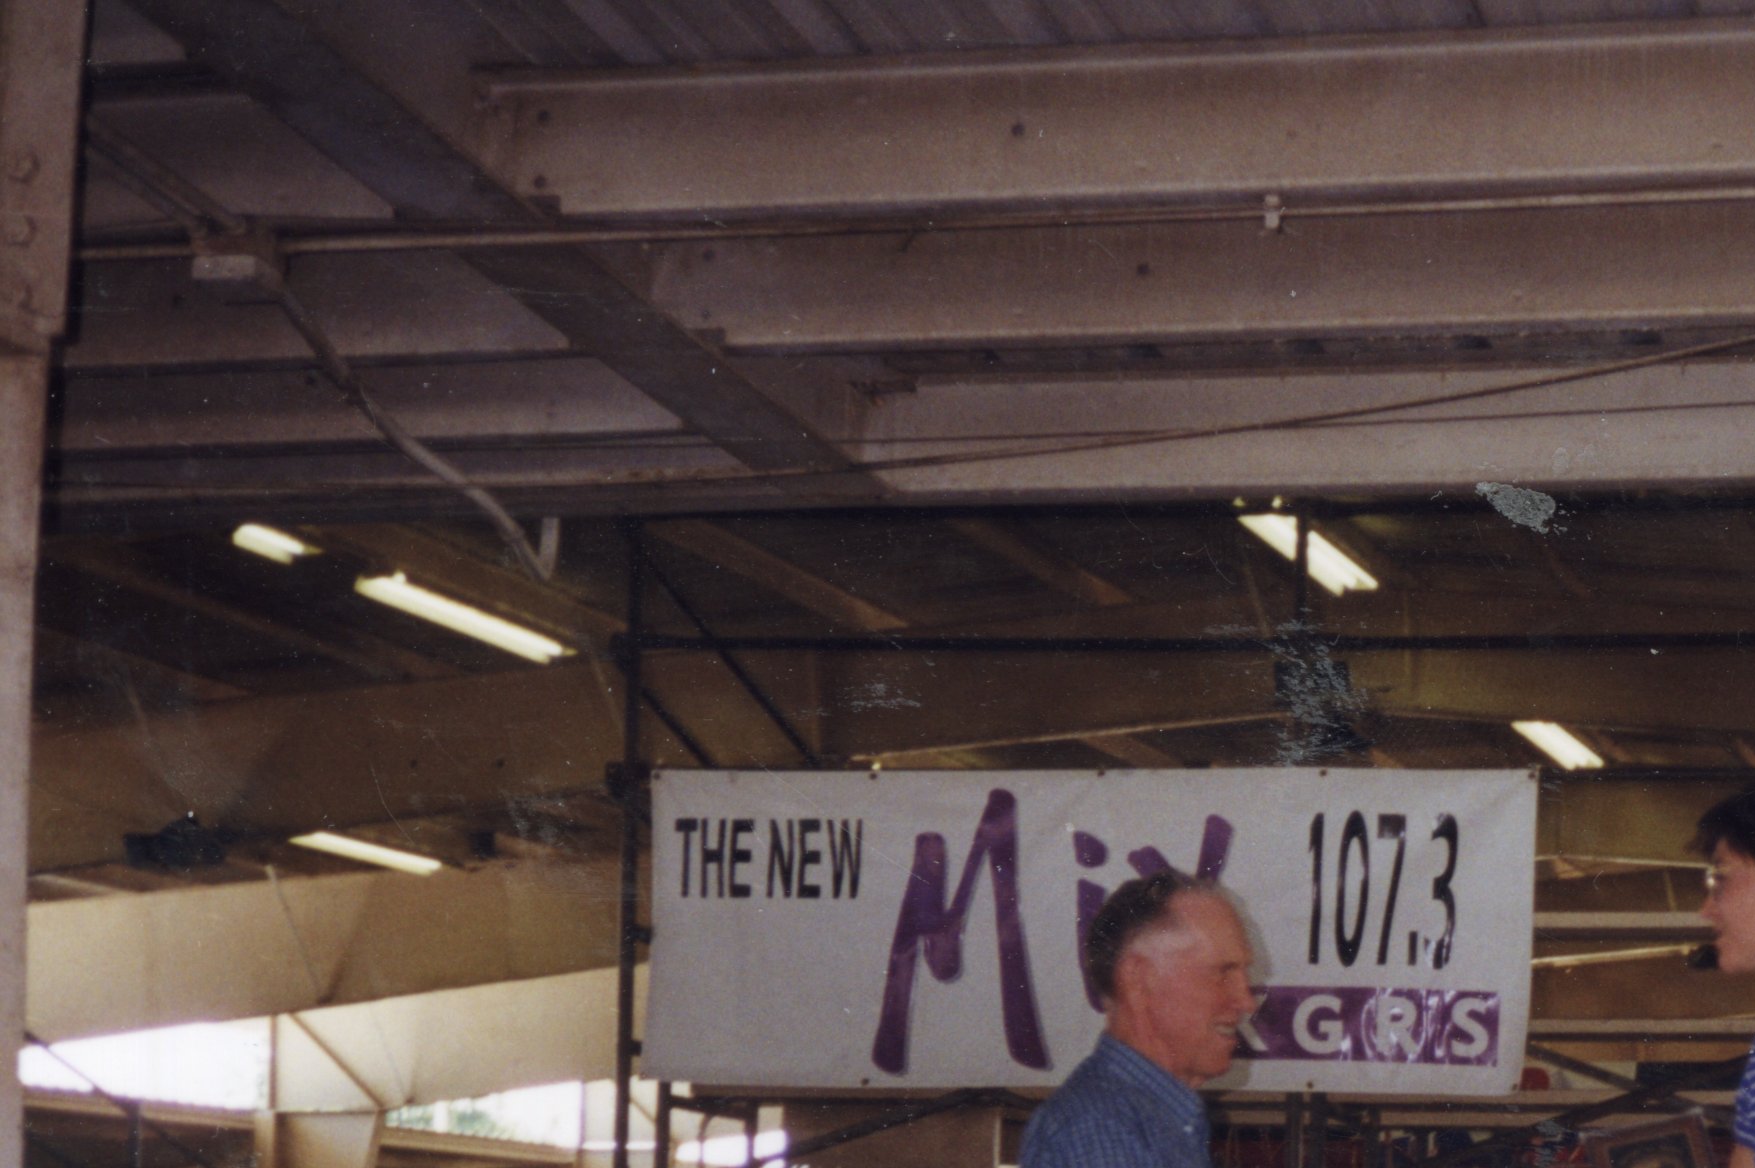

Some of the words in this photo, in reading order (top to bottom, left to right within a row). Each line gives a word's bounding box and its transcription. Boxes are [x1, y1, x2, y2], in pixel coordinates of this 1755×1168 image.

[674, 816, 755, 899] THE
[766, 816, 864, 900] NEW
[1308, 809, 1460, 970] 107.3
